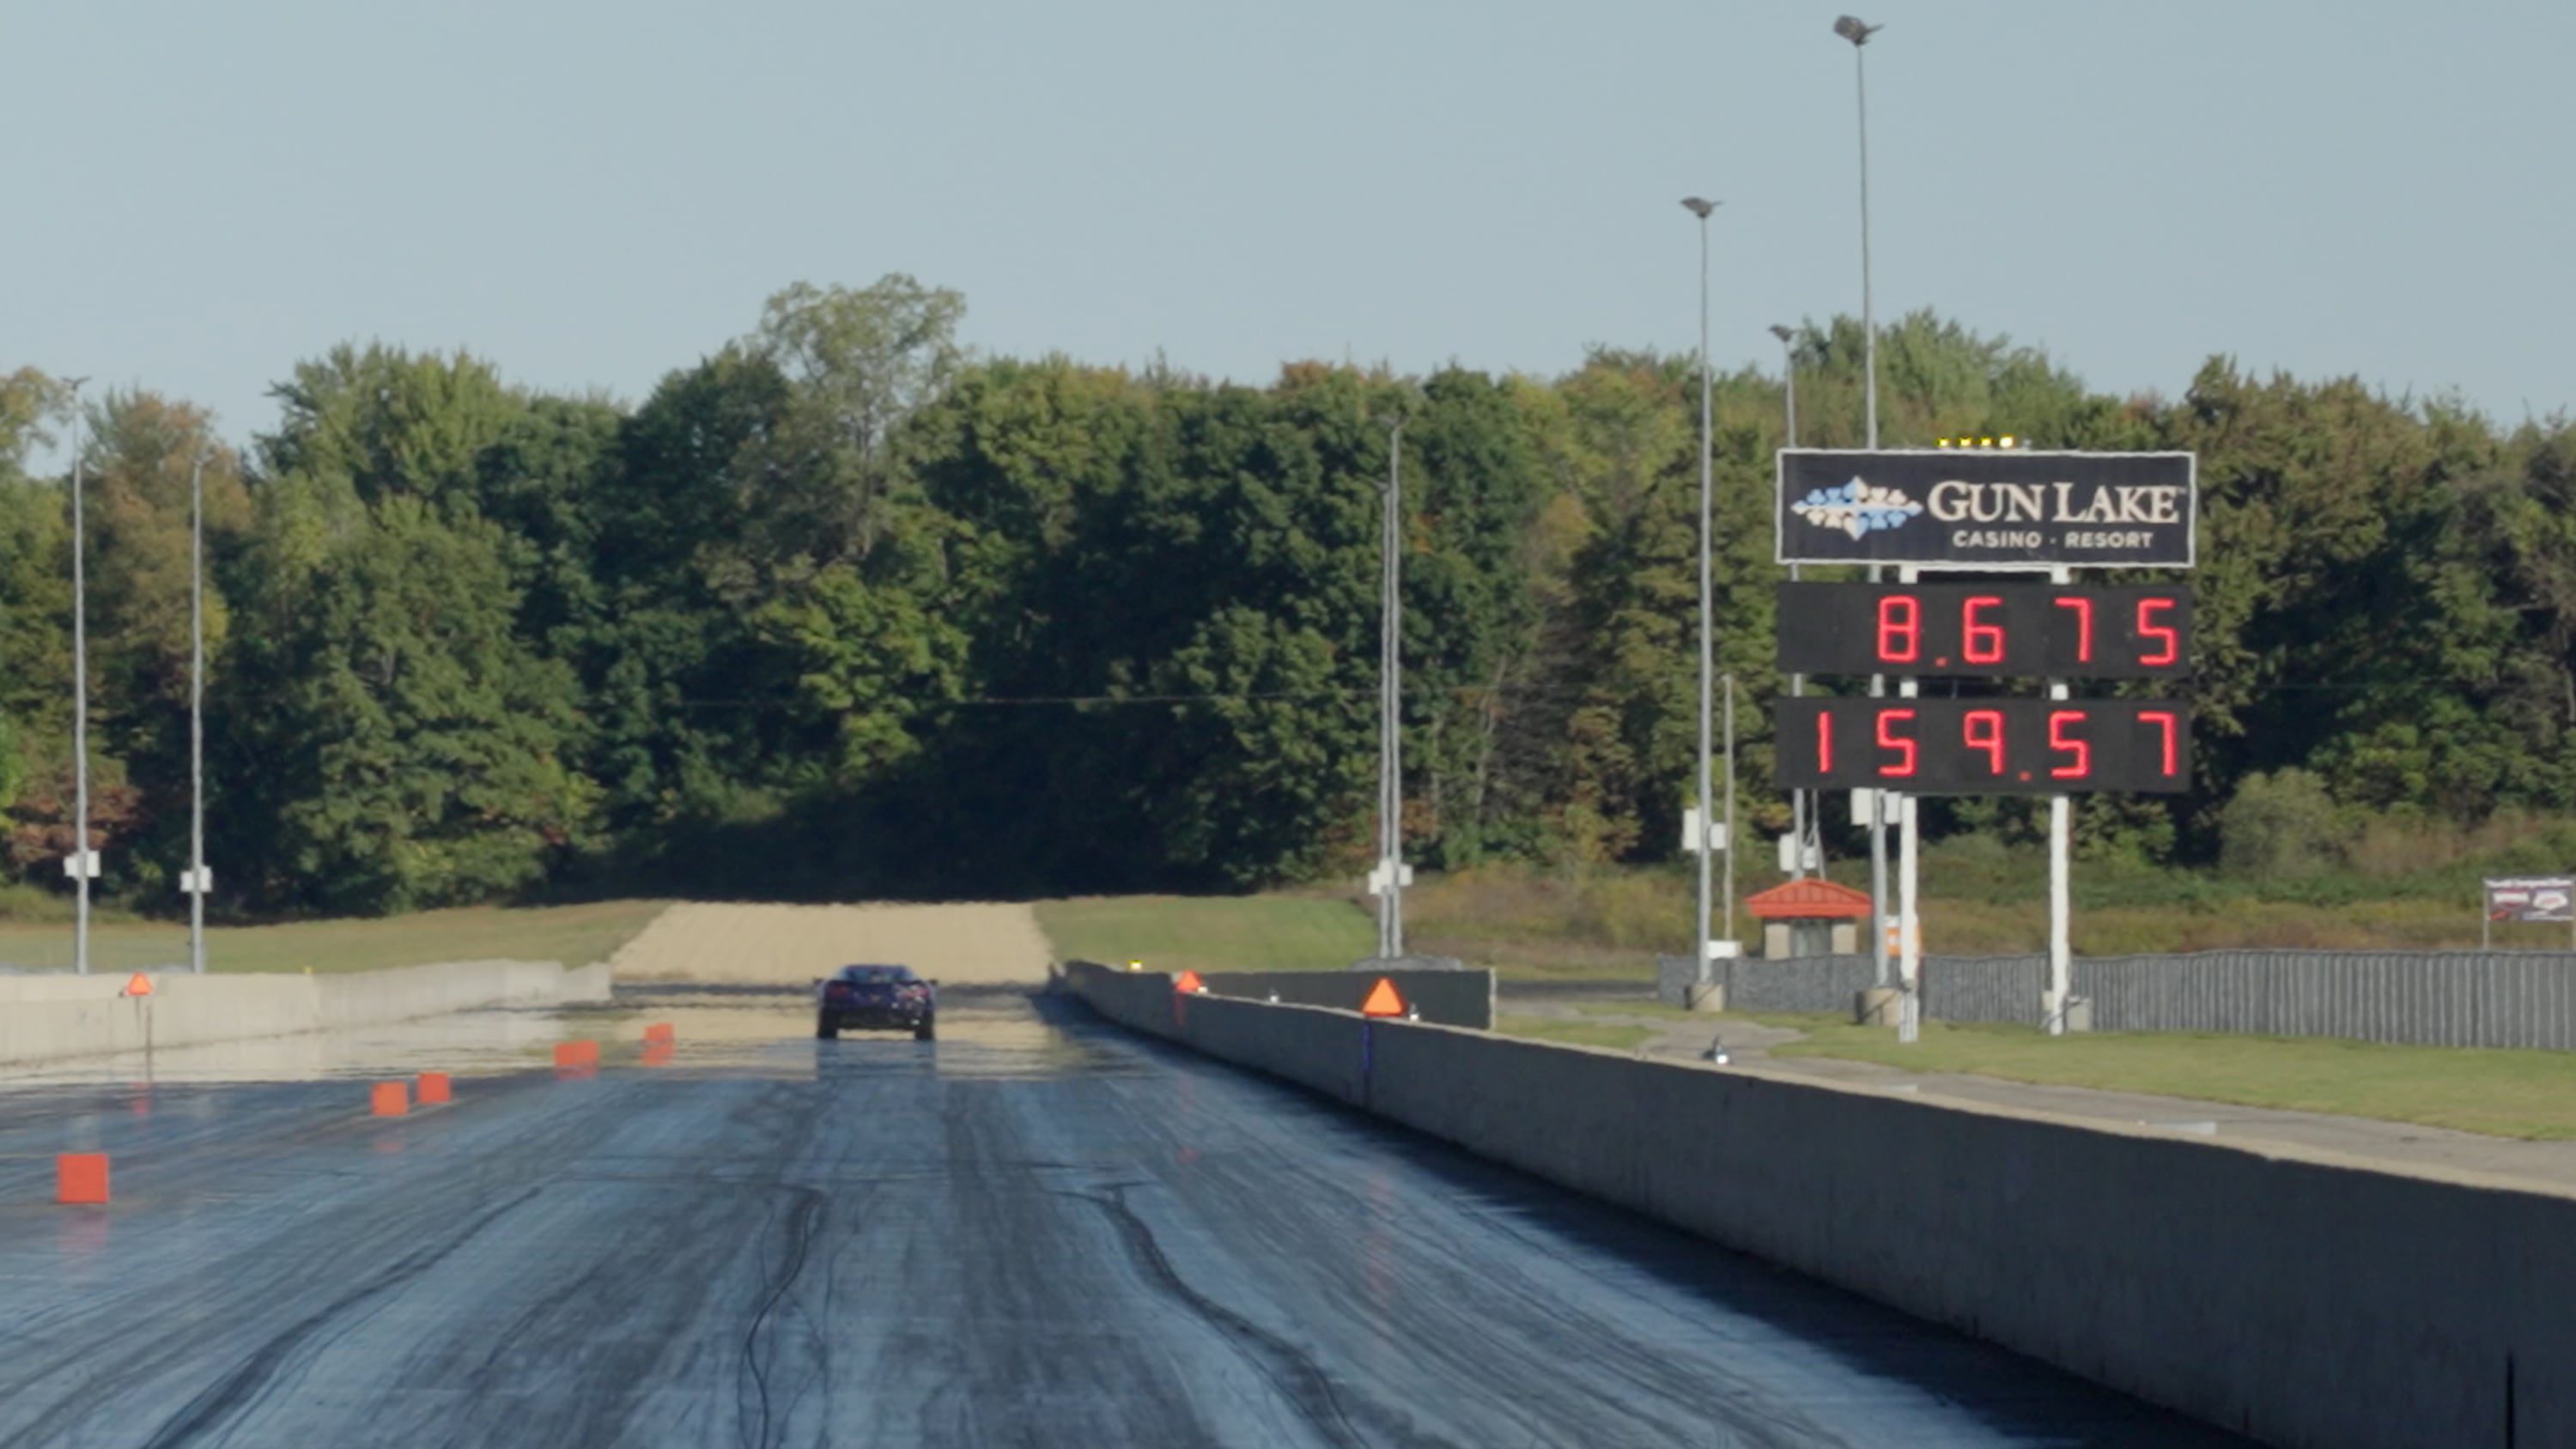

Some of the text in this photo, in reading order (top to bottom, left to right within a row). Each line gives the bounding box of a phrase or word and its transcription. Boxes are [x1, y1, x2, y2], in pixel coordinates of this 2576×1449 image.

[1928, 480, 2180, 524] GUN LAKE
[1953, 530, 2154, 549] CASINO RESORT
